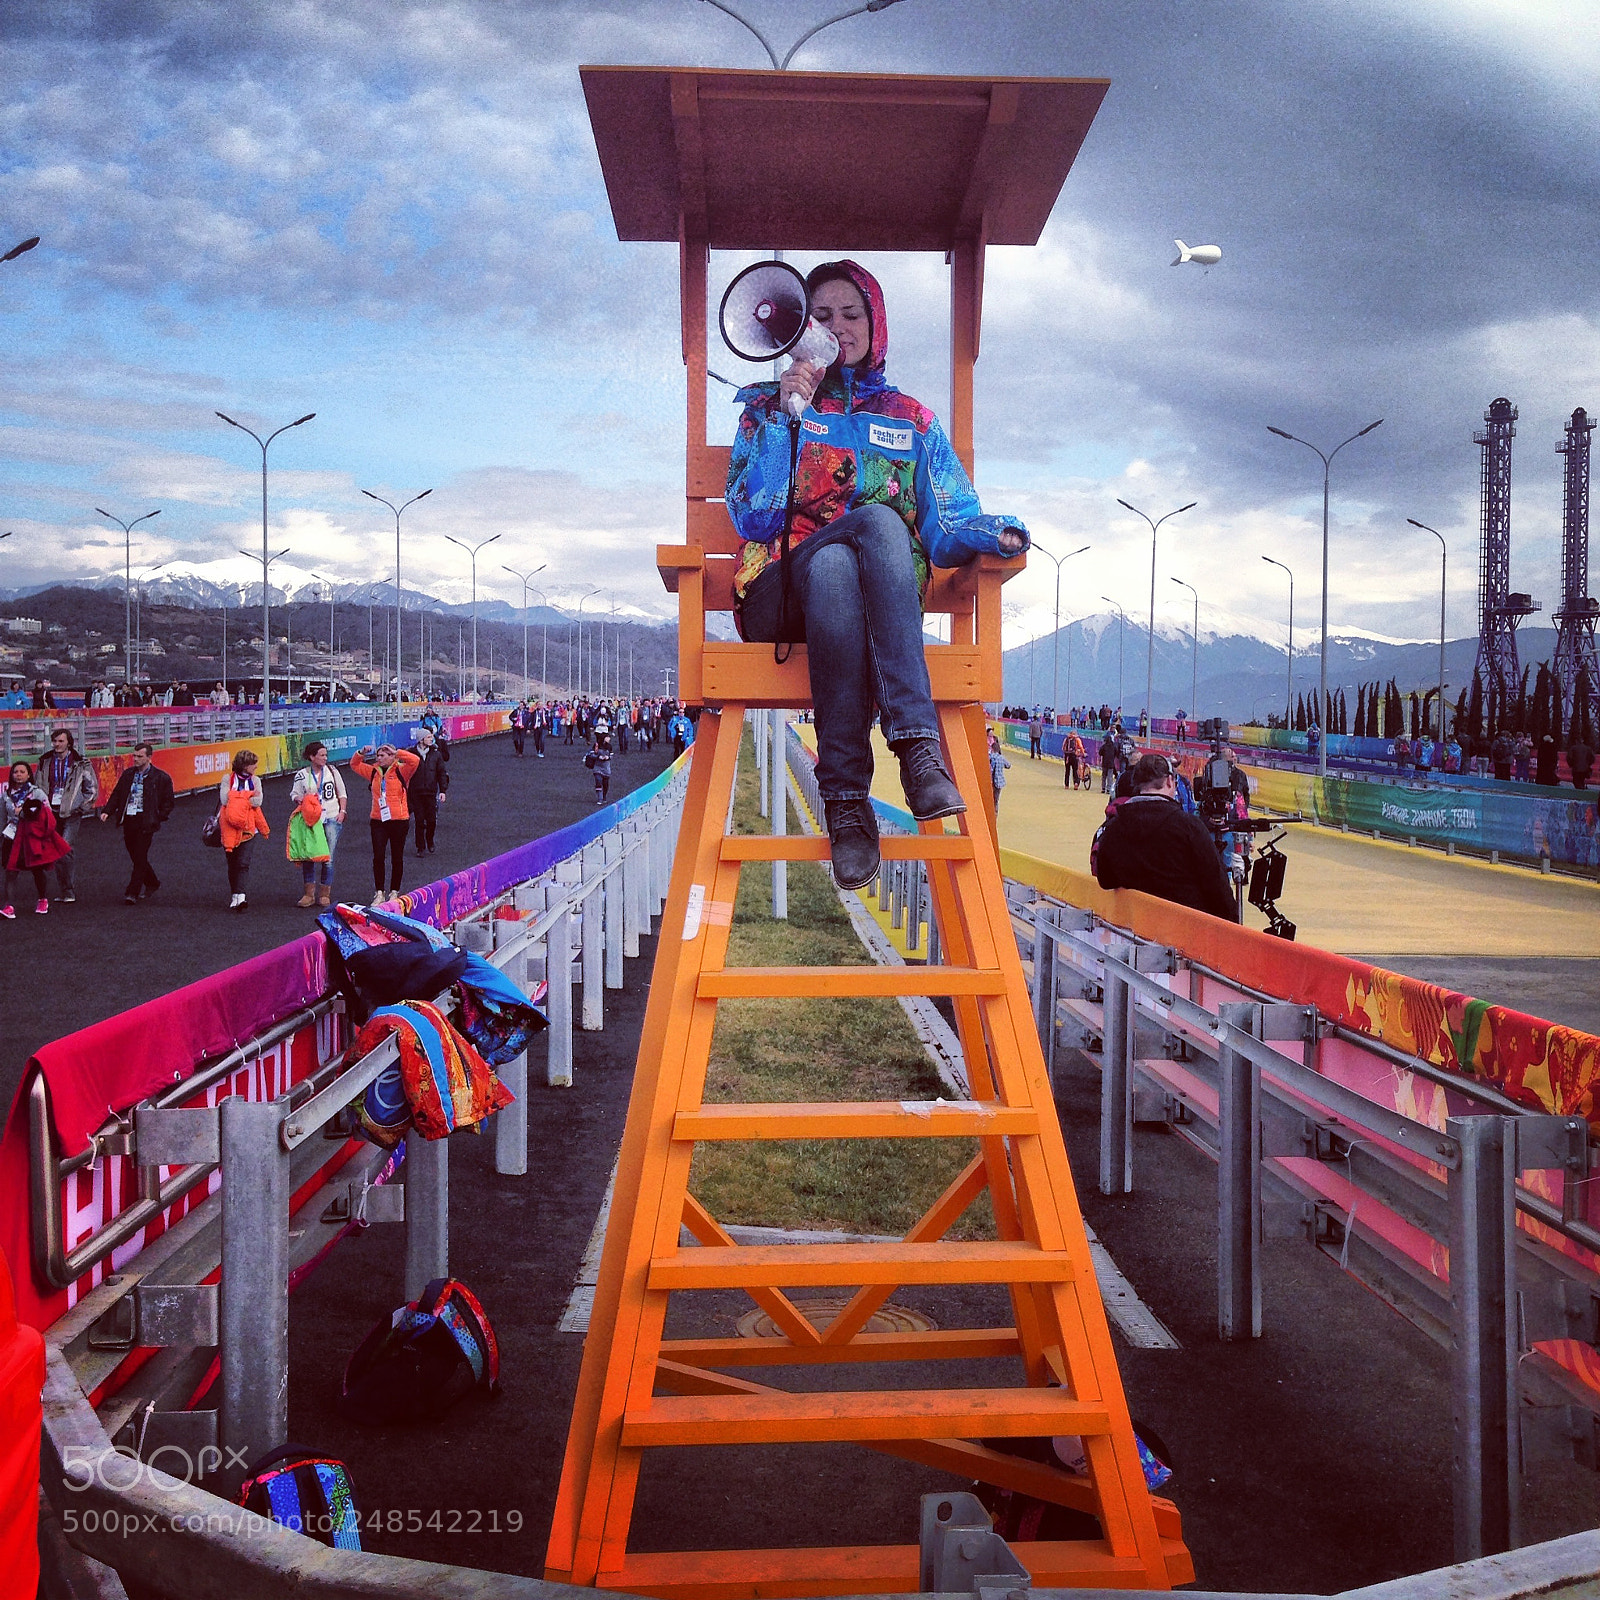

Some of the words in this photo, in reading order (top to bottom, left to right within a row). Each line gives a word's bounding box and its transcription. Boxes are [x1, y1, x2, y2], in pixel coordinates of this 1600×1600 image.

[873, 429, 907, 440] sochi.ru
[877, 435, 894, 446] 2014
[194, 753, 214, 775] SOCHI
[215, 751, 230, 772] 2014
[323, 781, 335, 800] 8
